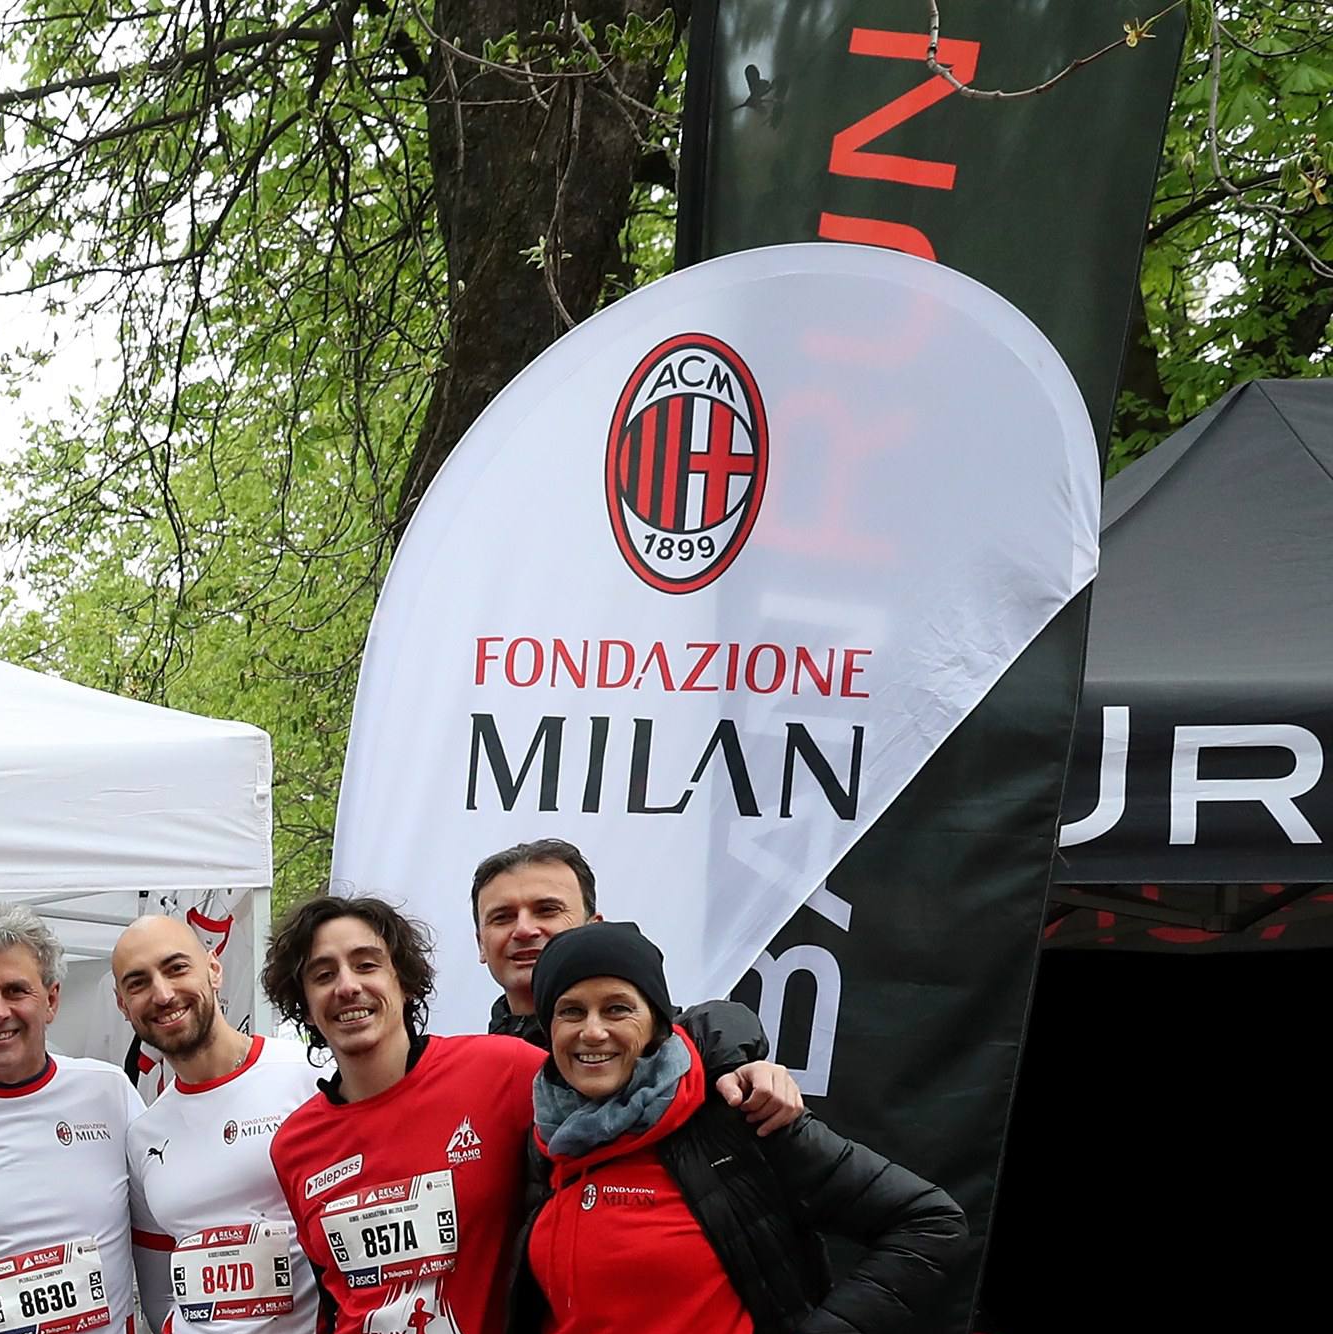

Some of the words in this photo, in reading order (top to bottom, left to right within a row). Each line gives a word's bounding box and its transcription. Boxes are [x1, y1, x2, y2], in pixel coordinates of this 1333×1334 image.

[647, 355, 735, 402] ACM
[642, 531, 716, 563] 1899
[472, 636, 873, 699] FONDAZIONE
[464, 711, 865, 821] MILAN
[75, 1129, 111, 1141] MILAN
[448, 1148, 480, 1159] MILANO
[313, 1159, 360, 1190] Telepass
[378, 1185, 406, 1195] RELAY
[603, 1185, 656, 1195] FONDAZIONE
[219, 1230, 243, 1238] RELAY
[361, 1220, 419, 1258] 857A
[34, 1250, 59, 1261] RELAY
[202, 1262, 255, 1295] 847D
[354, 1273, 377, 1286] asics
[19, 1281, 77, 1318] 863C
[87, 1311, 109, 1322] MILANO
[189, 1309, 209, 1320] asics
